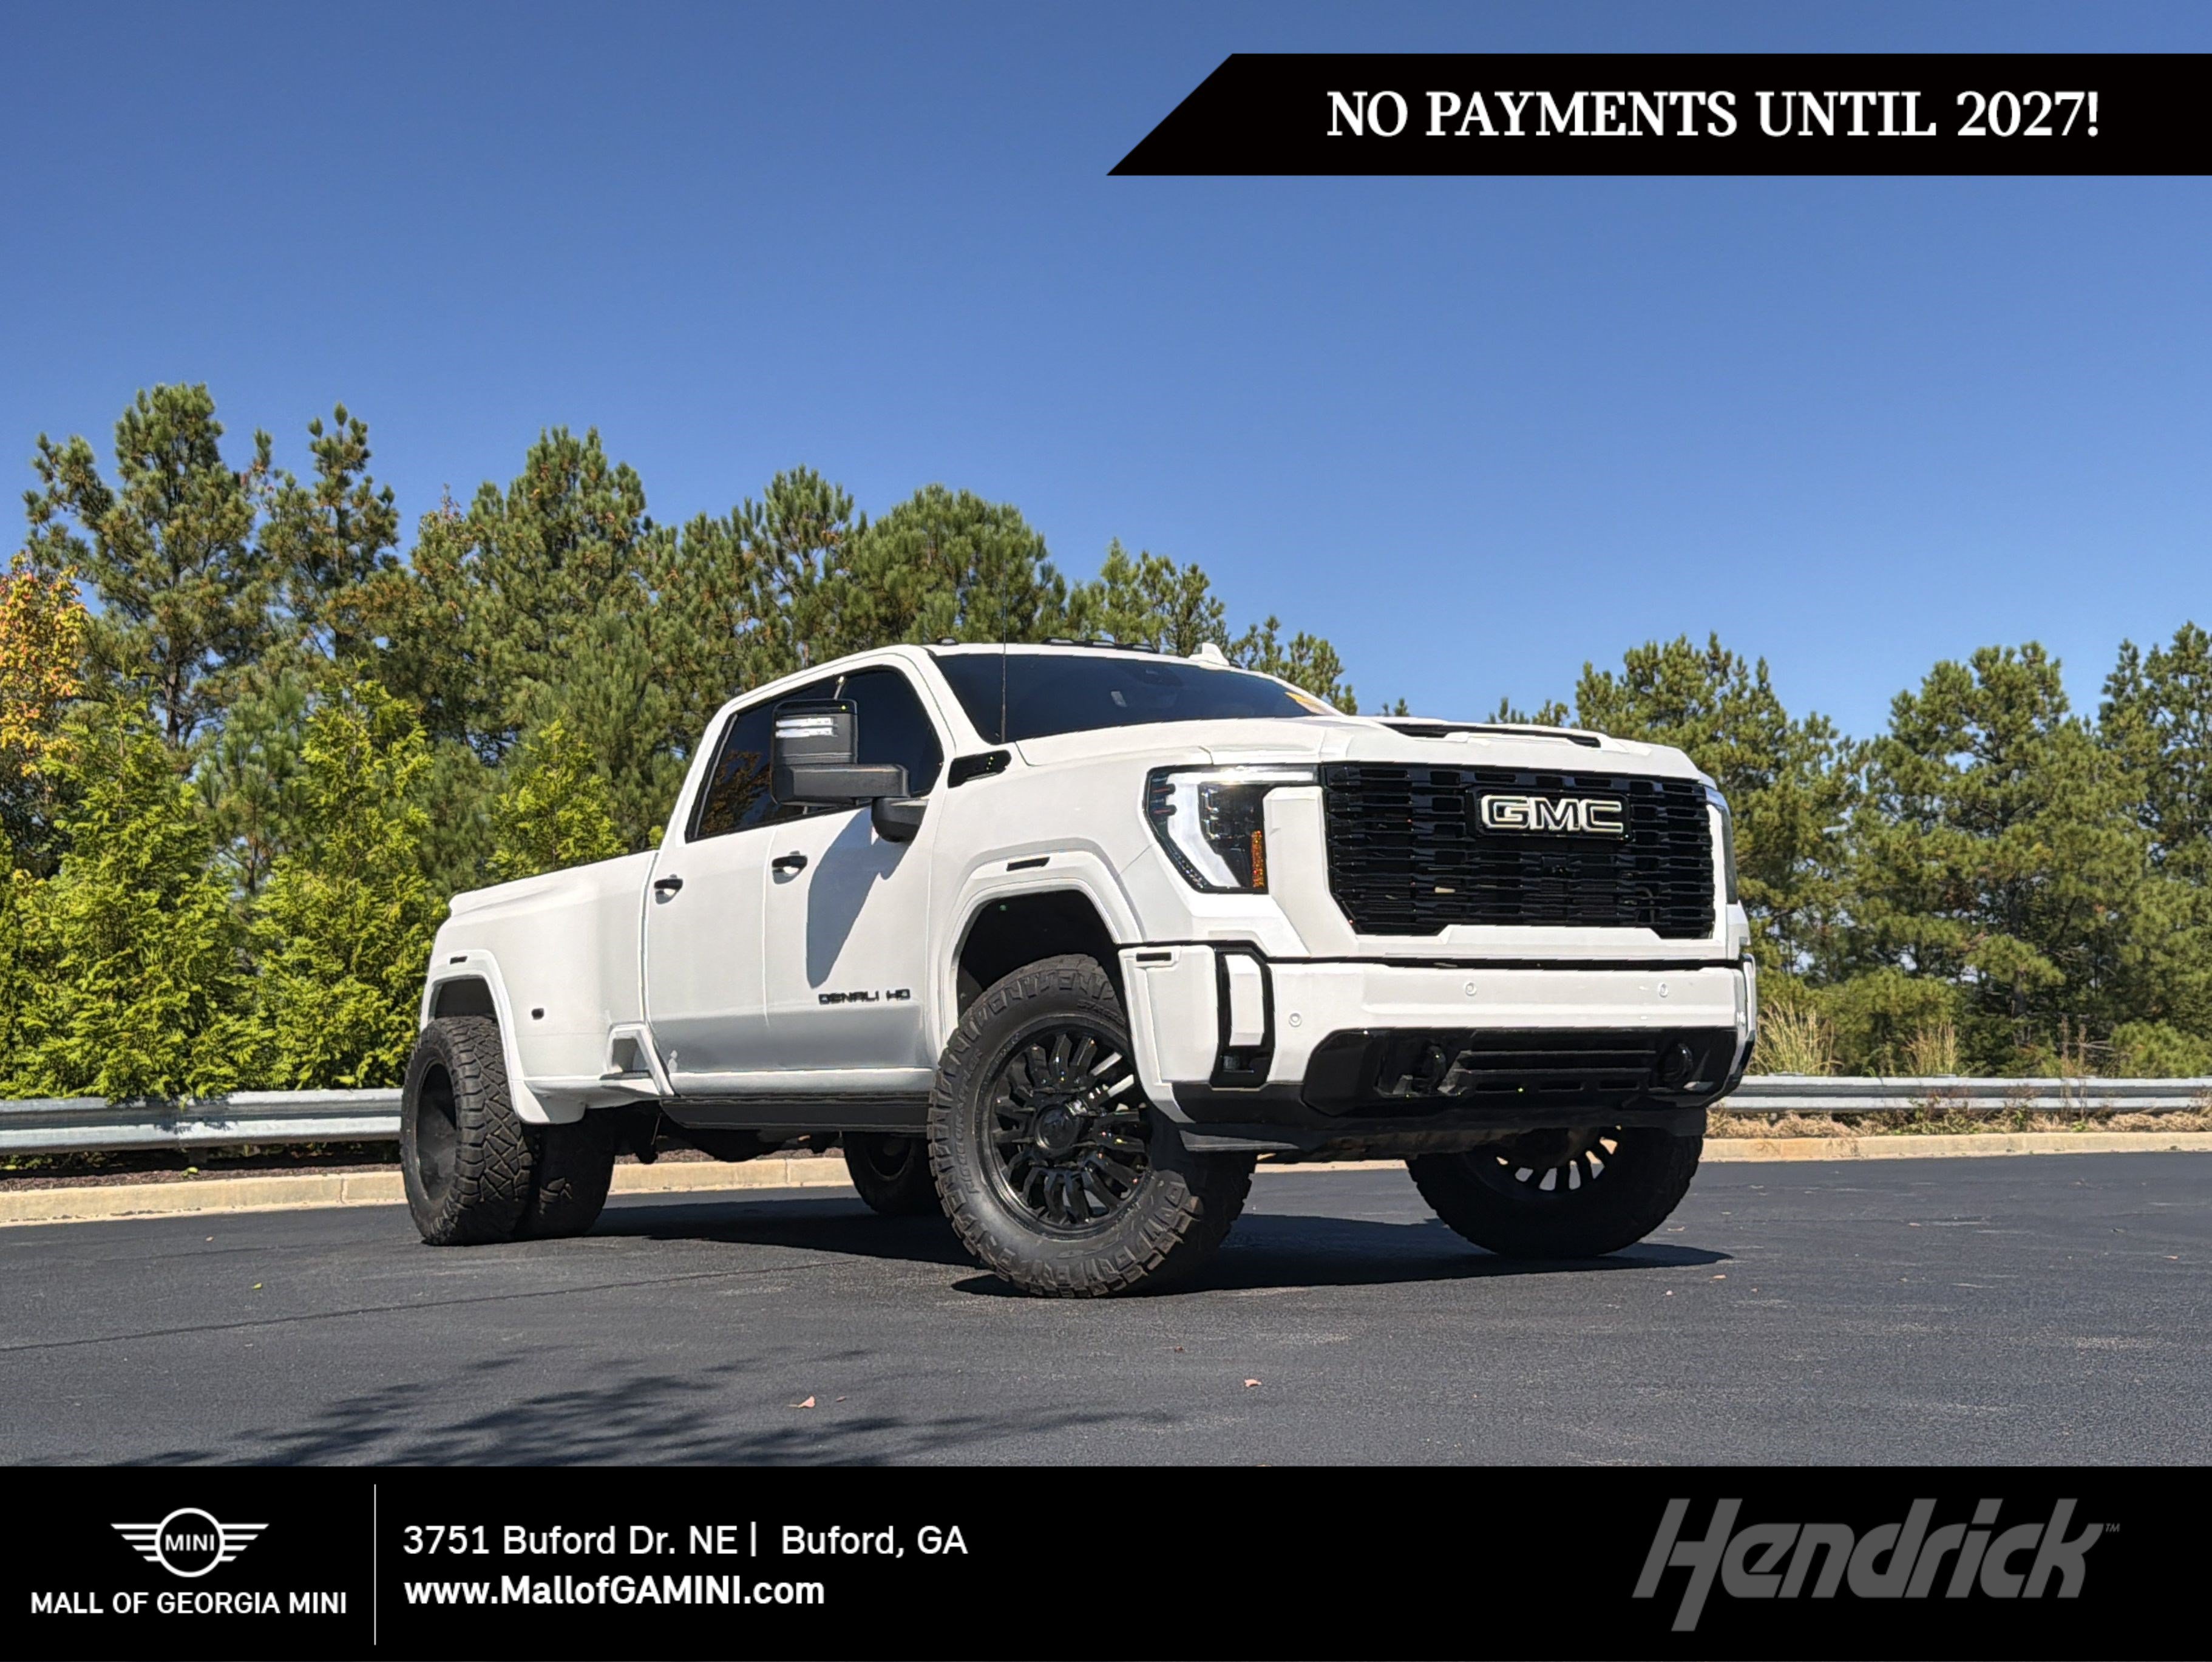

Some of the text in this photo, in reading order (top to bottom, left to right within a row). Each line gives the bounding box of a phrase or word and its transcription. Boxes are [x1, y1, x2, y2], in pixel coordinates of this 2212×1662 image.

[1481, 795, 1623, 833] GMC
[819, 988, 911, 1005] DENALI HD
